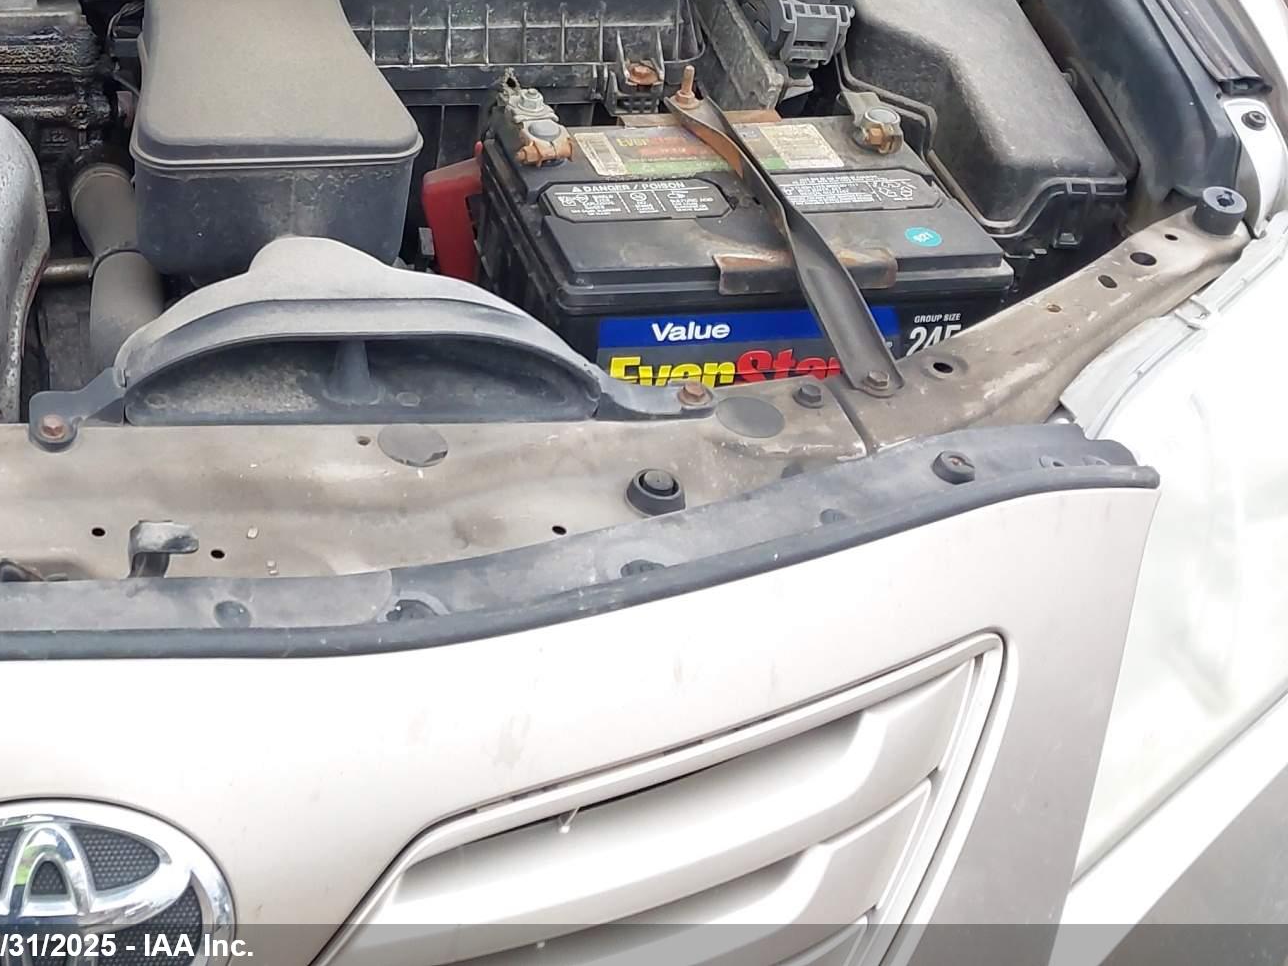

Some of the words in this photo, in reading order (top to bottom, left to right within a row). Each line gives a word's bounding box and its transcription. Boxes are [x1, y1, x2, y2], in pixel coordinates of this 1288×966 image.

[583, 184, 630, 192] DANGER
[642, 182, 685, 190] POISON
[914, 314, 943, 324] GROUP
[943, 313, 961, 322] SIZE
[651, 321, 731, 342] Value
